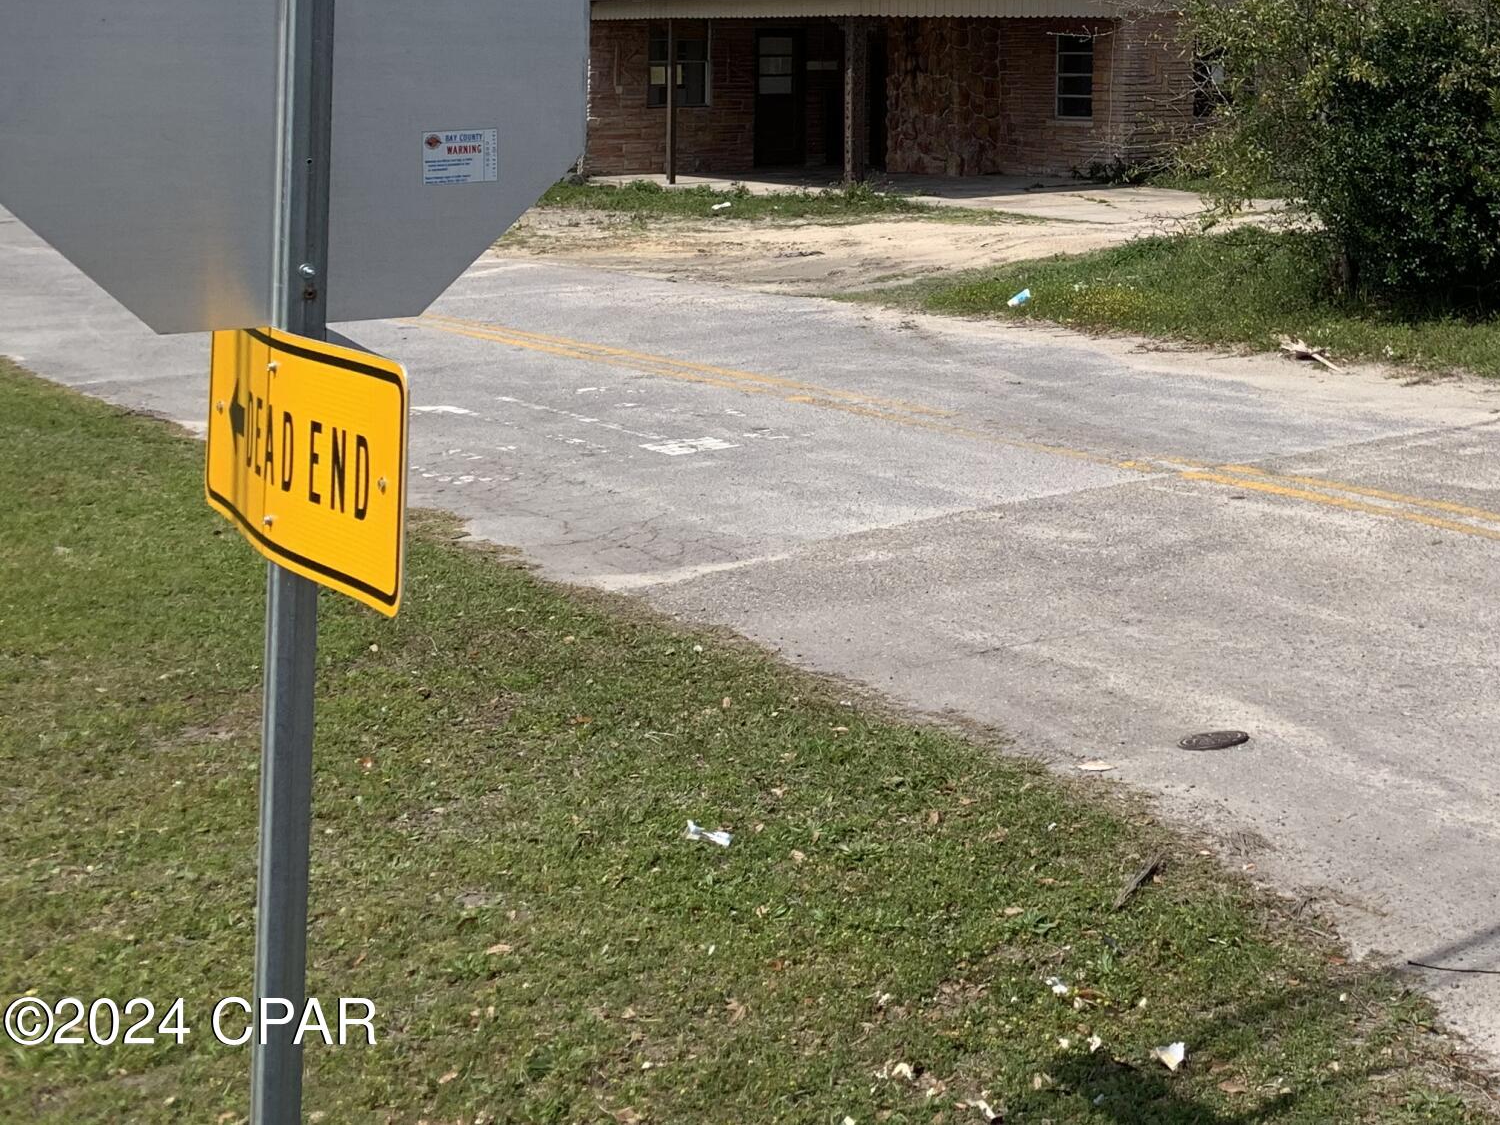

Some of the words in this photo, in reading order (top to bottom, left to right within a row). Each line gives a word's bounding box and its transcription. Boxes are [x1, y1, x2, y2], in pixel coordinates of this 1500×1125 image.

[447, 145, 482, 155] WARNING
[246, 392, 294, 492] DEAD
[308, 420, 370, 521] END
